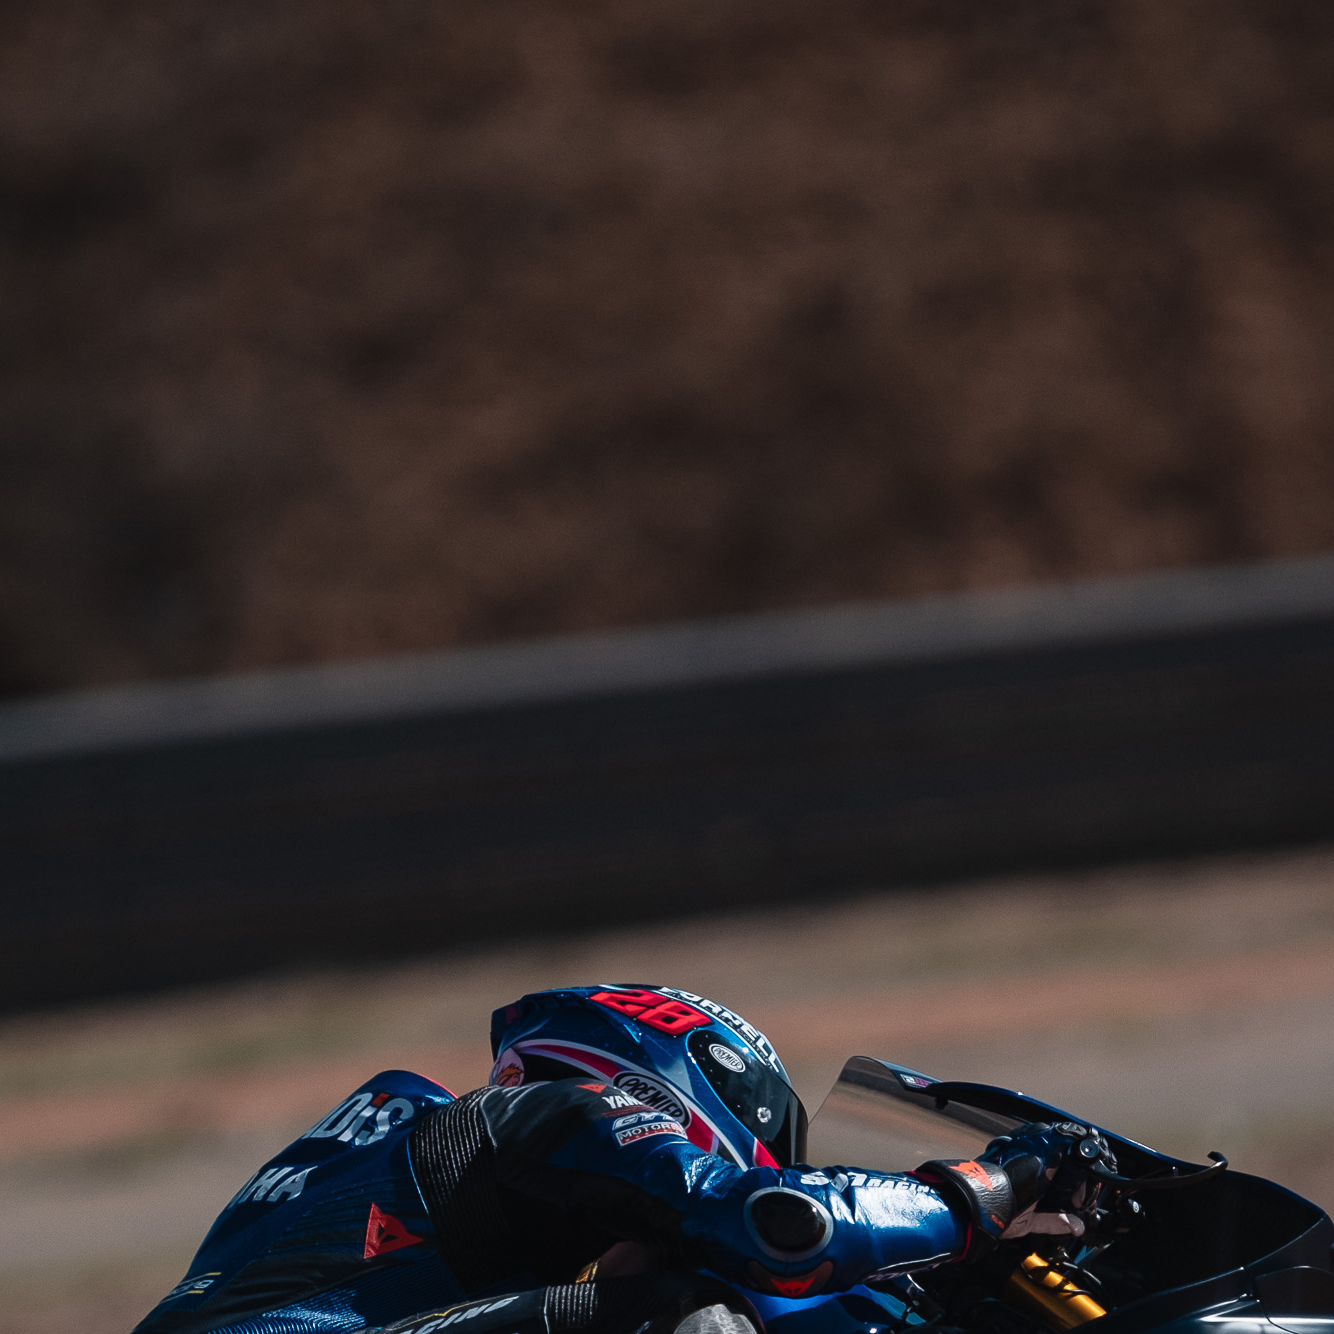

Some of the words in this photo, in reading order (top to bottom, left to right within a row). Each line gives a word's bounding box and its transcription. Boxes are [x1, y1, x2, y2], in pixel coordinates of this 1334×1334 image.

[588, 988, 713, 1038] 28
[620, 1077, 684, 1121] PREMIER
[228, 1166, 318, 1209] HA
